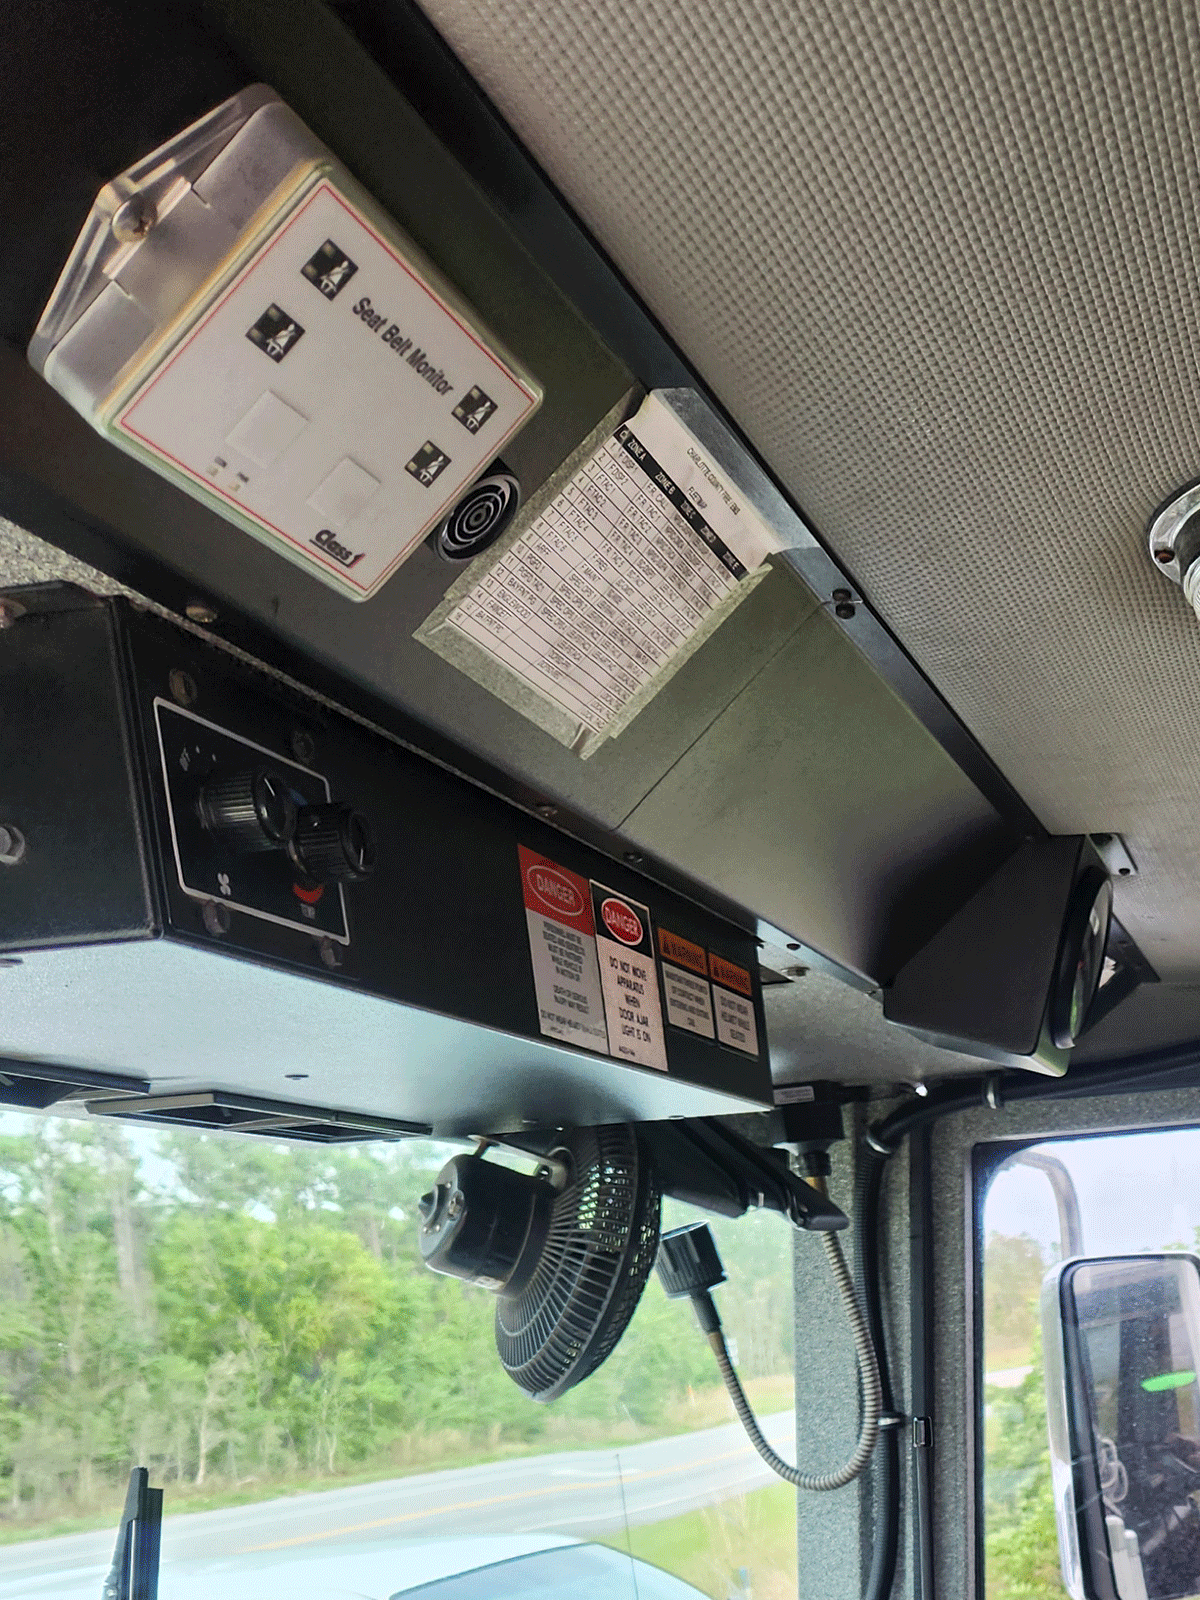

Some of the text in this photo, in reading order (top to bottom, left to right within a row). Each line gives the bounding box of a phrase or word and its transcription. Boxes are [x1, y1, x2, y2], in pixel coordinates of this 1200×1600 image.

[350, 294, 457, 398] Seat Belt Monitor
[626, 438, 643, 457] ZONE
[685, 446, 712, 477] CHARLOTTE
[654, 470, 672, 490] ZONE
[312, 525, 357, 562] Class
[535, 872, 576, 908] DANGER
[604, 905, 638, 937] DANGER
